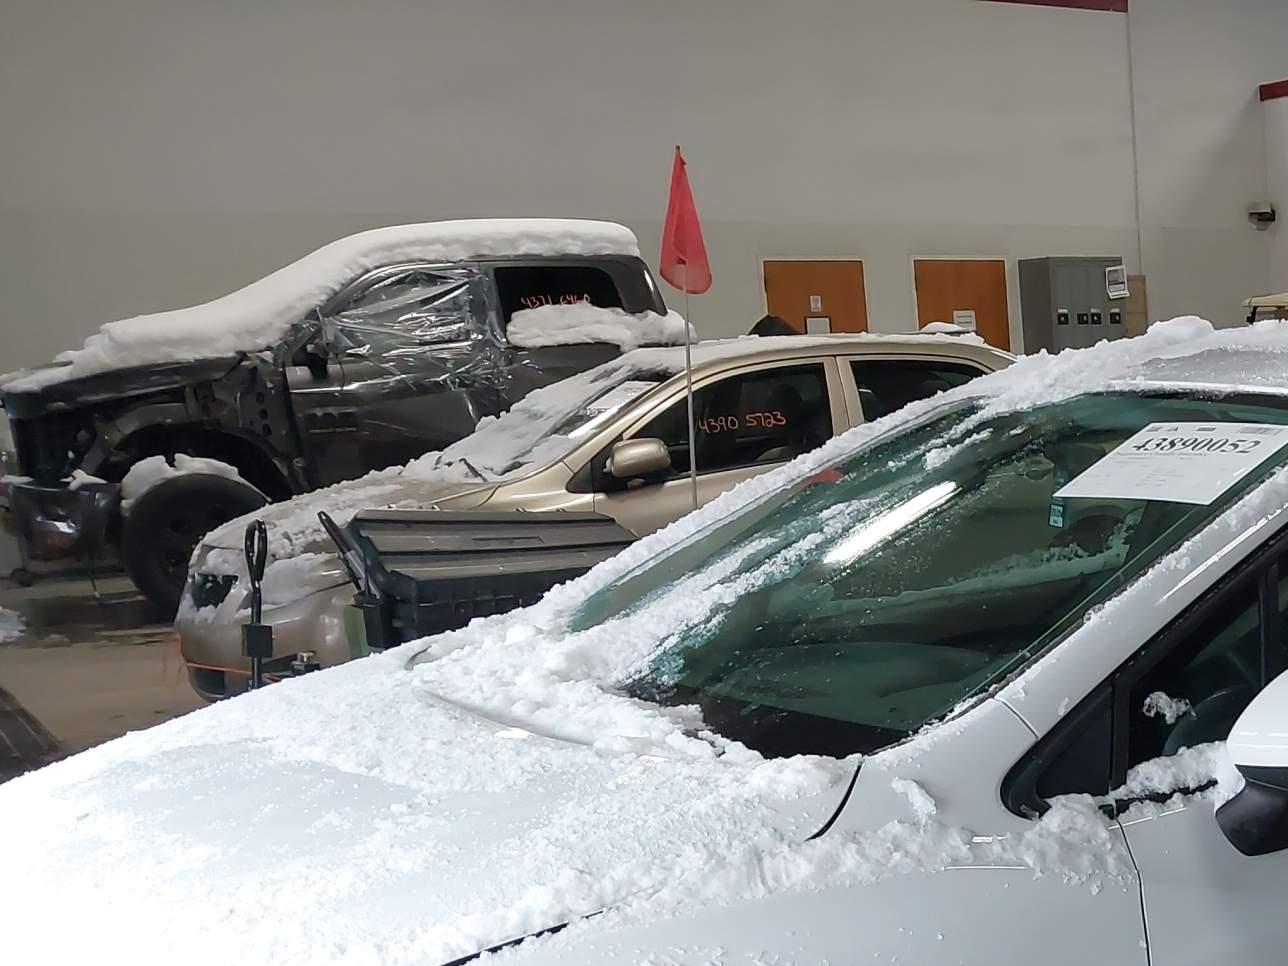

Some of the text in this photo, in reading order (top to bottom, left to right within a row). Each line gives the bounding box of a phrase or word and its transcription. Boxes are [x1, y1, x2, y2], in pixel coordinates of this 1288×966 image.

[698, 411, 786, 434] 4390 5723
[1132, 437, 1262, 453] 43890052
